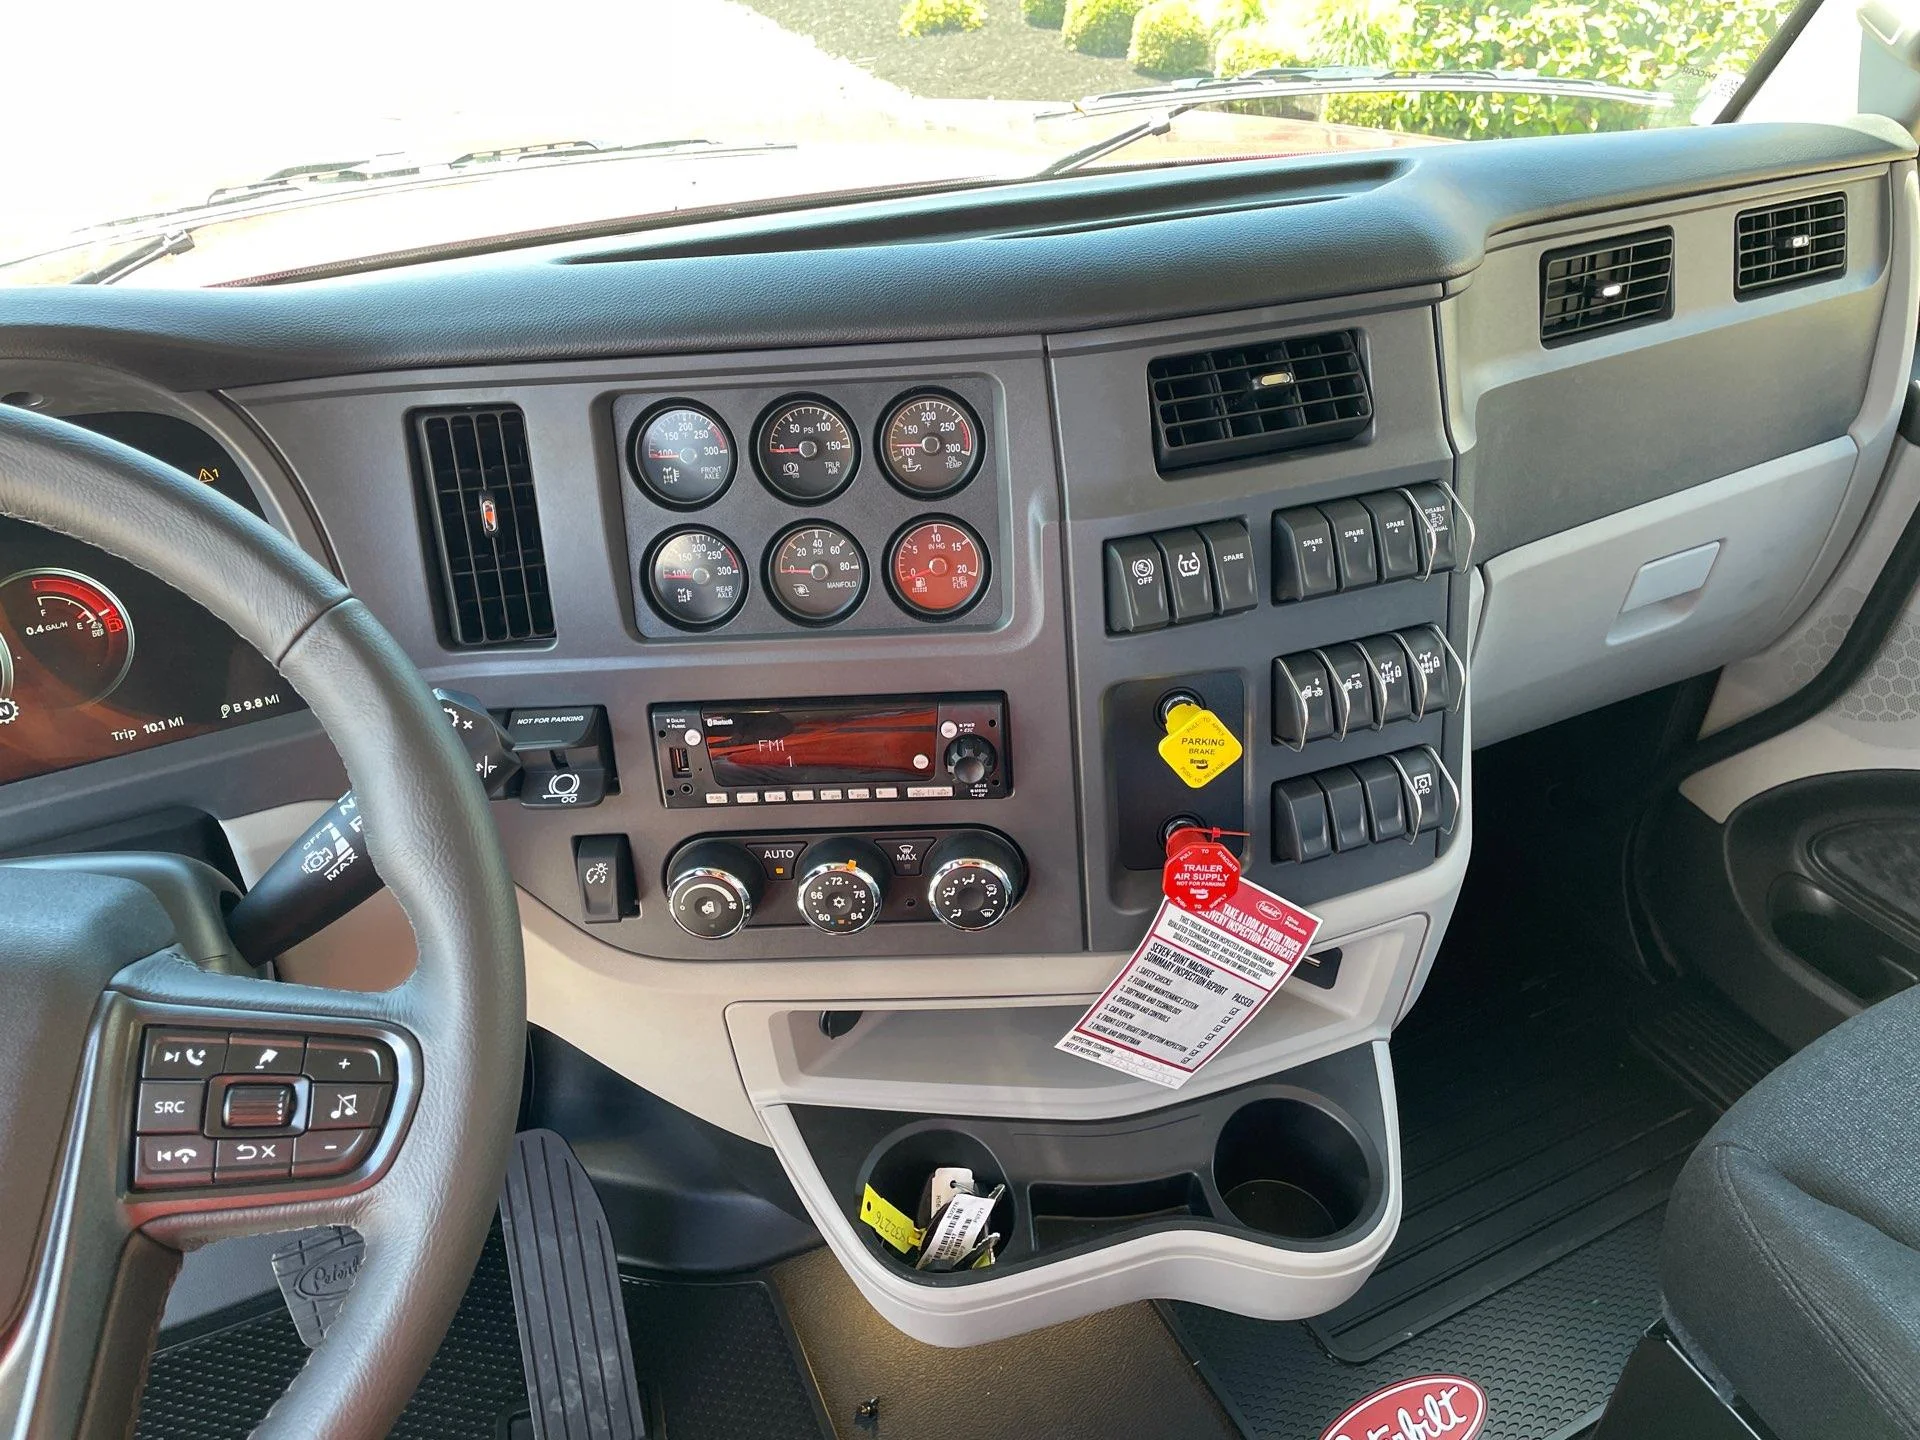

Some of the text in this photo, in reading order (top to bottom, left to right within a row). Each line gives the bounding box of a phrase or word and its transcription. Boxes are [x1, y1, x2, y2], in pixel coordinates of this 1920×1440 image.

[921, 412, 936, 421] 200
[679, 423, 692, 431] 200
[790, 425, 800, 433] 50
[816, 423, 831, 431] 100
[903, 425, 918, 434] 150
[940, 422, 955, 431] 250
[665, 432, 678, 440] 150
[694, 430, 708, 439] 250
[826, 441, 841, 450] 150
[946, 443, 960, 452] 300
[901, 447, 915, 456] 100
[214, 469, 219, 478] 1
[1425, 506, 1445, 514] DISABLE
[1386, 520, 1405, 529] SPARE
[932, 534, 941, 542] 10
[1345, 529, 1364, 538] SPARE
[813, 539, 822, 548] 40
[952, 542, 961, 551] 15
[1303, 538, 1322, 547] SPARE
[692, 544, 706, 552] 200
[797, 547, 806, 556] 20
[830, 546, 840, 554] 60
[707, 551, 721, 559] 250
[1224, 553, 1244, 561] SPARE
[840, 562, 850, 570] 80
[957, 565, 967, 573] 20
[1181, 560, 1196, 571] TC
[717, 567, 731, 575] 300
[911, 568, 916, 576] 0
[827, 581, 856, 589] MANIFOLD
[1138, 577, 1152, 585] OFF
[26, 621, 68, 635] 0.4 GAL/H
[233, 694, 280, 713] B 9.8 MI
[112, 717, 184, 742] Trip 10.1 MI
[759, 740, 784, 752] FM1
[1181, 738, 1225, 746] PARKING
[786, 756, 792, 767] 1
[339, 797, 356, 815] N
[303, 831, 325, 850] OFF
[764, 850, 794, 858] AUTO
[1180, 851, 1193, 861] PULL
[1217, 850, 1238, 872] EVACUATE
[326, 853, 359, 881] MAX
[1184, 864, 1223, 872] TRAILER
[831, 877, 842, 885] 72
[1193, 873, 1230, 881] SUPPLY
[1209, 893, 1227, 908] SUPPLY
[1222, 904, 1239, 920] TAKE
[1242, 916, 1260, 931] LOOK
[1258, 924, 1268, 934] AT
[1266, 928, 1283, 943] YOUR
[1282, 936, 1301, 952] TRUCK
[1173, 932, 1190, 944] QUALITY
[1188, 930, 1210, 944] TECHNICIAN
[1189, 920, 1202, 931] TRUCK
[1219, 936, 1239, 950] INSPECTED
[1227, 920, 1296, 961] INSPECTION CERTIFICATE
[1151, 943, 1214, 978] SEVEN-POINT MACHINE
[1139, 967, 1172, 986] SAFETY CHECKS
[1144, 952, 1228, 995] SUMMARY INSPECTION REPORT
[1132, 977, 1146, 987] FLUID
[1154, 987, 1183, 1003] MAINTENANCE
[1181, 999, 1199, 1010] SYSTEM
[1124, 987, 1148, 1000] SOFTWARE
[1155, 1000, 1181, 1014] TECHNOLOGY
[1232, 993, 1254, 1007] PASSED
[1117, 996, 1141, 1010] OPERATION
[1148, 1010, 1170, 1022] CONTROLS
[1118, 1009, 1134, 1019] REVIEW
[1116, 1033, 1141, 1045] DRIVETRAIN
[155, 1101, 185, 1113] SRC
